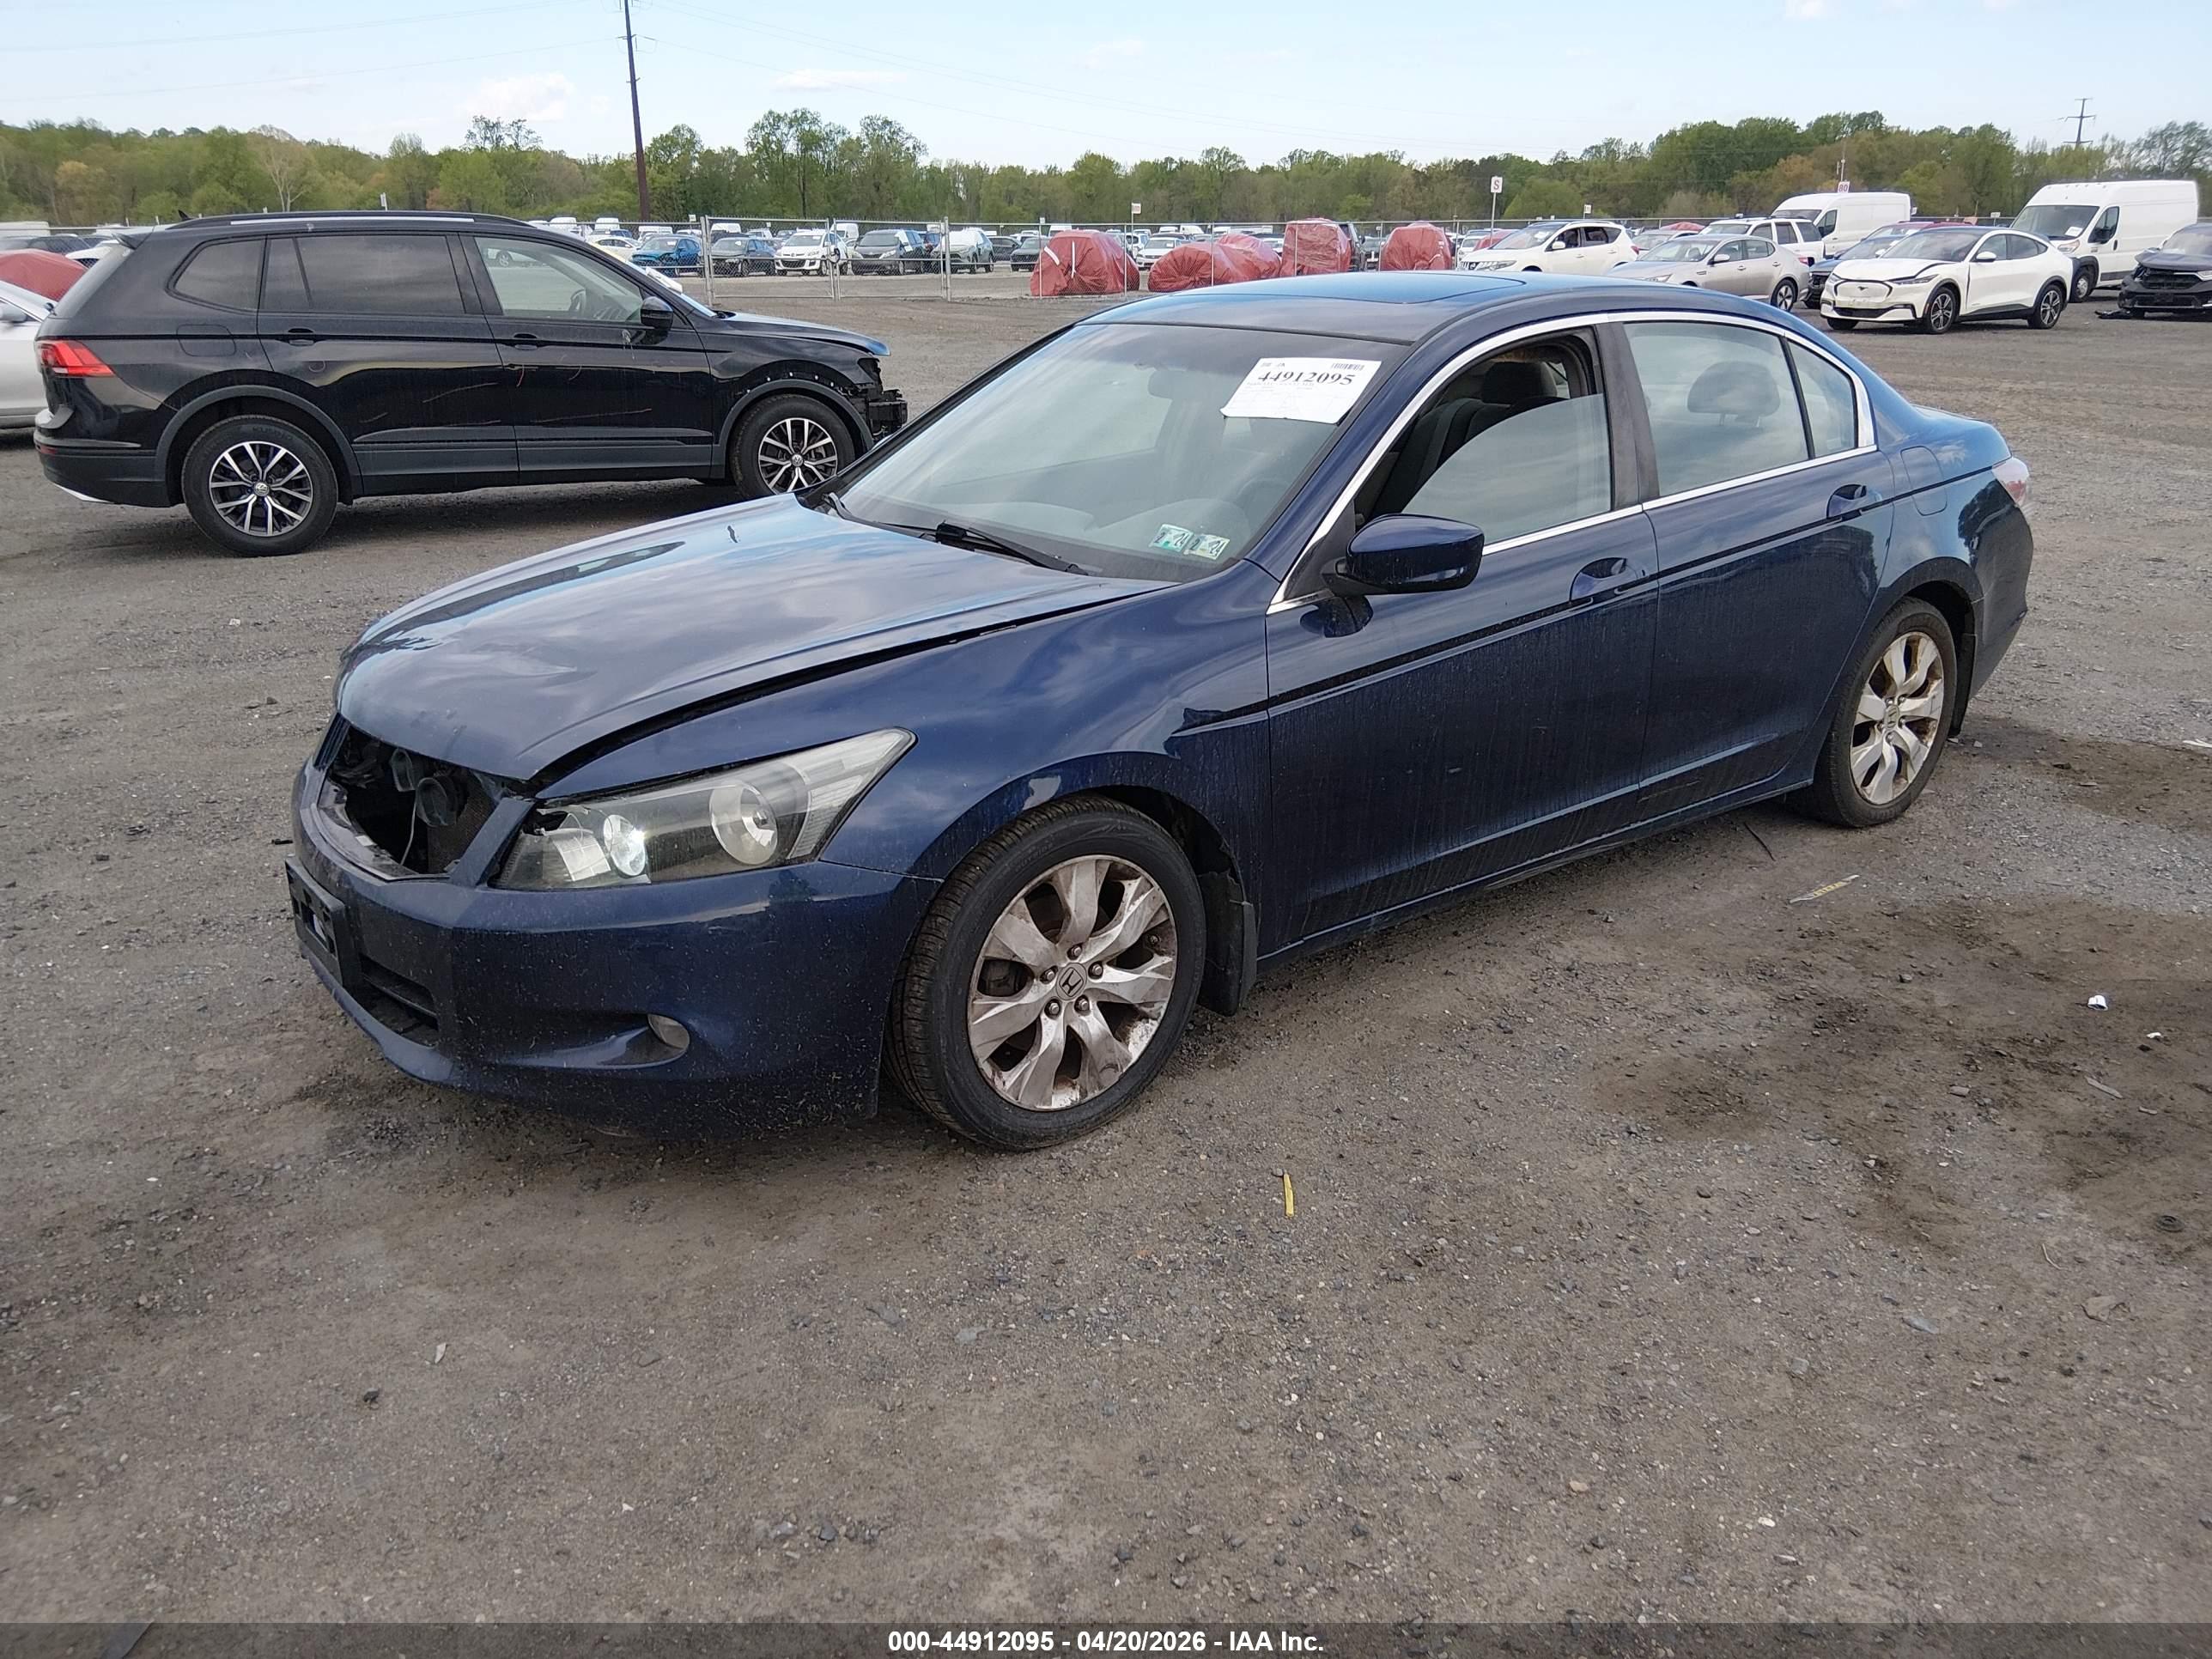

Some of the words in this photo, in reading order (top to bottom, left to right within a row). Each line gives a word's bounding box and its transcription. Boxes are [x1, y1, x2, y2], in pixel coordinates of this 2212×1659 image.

[1493, 179, 1500, 191] S
[1838, 184, 1849, 192] 80
[1257, 371, 1356, 386] 44912095
